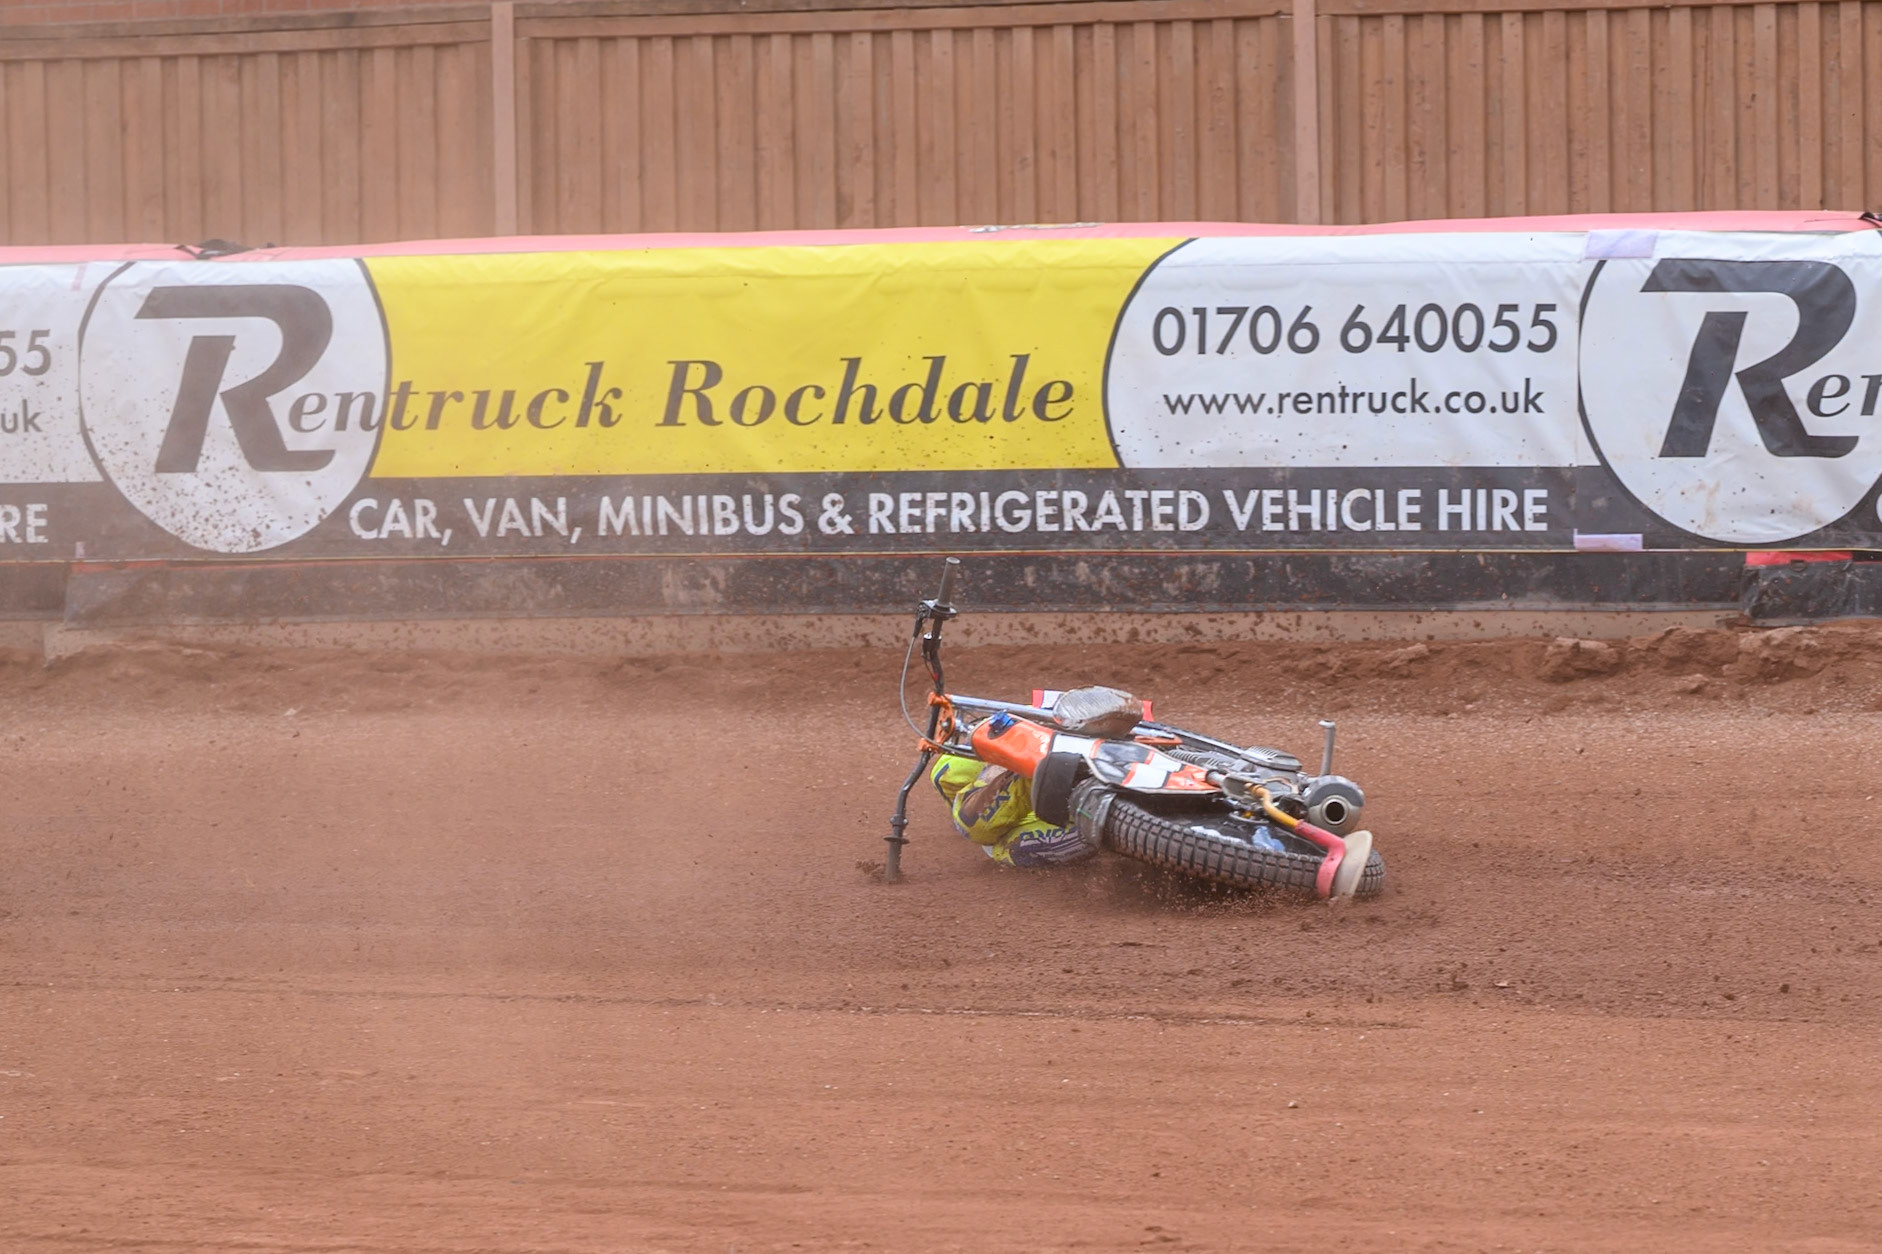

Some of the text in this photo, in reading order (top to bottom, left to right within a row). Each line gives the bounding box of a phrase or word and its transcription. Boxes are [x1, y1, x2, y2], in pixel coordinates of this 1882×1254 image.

[1152, 302, 1559, 357] 01706 640055
[133, 284, 1075, 474] Rentruck Rochdale
[1162, 377, 1545, 416] www.rentruck.co.uk
[0, 503, 49, 543] RE
[349, 488, 1549, 546] CAR, VAN, MINIBUS & REFRIGERATED VEHICLE HIRE
